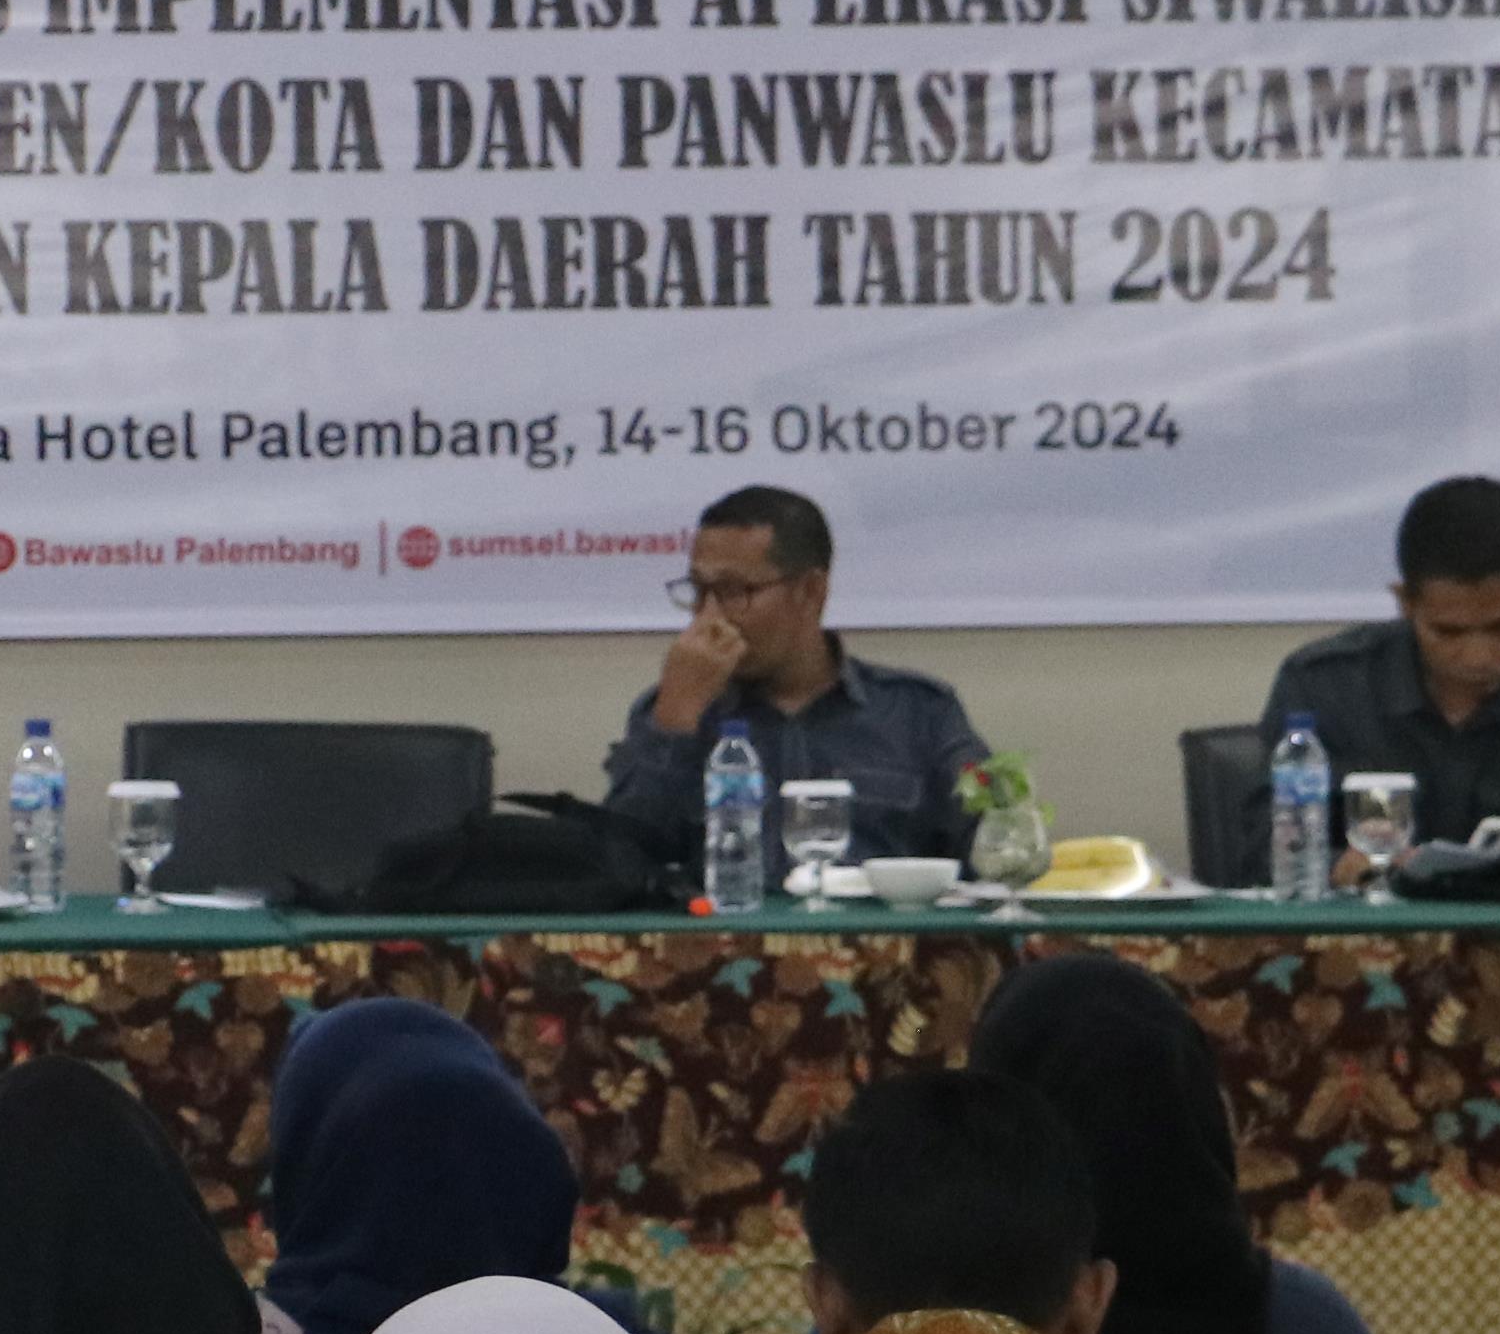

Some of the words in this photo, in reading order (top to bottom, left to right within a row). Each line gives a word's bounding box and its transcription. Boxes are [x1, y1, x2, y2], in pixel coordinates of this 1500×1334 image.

[413, 74, 585, 171] DAN
[617, 69, 1058, 169] PANWASLU
[63, 217, 389, 315] KEPALA
[419, 213, 770, 312] DAERAH
[803, 210, 1077, 307] TAHUN
[1108, 207, 1336, 304] 2024
[35, 410, 200, 462] Hotel
[221, 407, 577, 470] Palembang,
[597, 405, 751, 456] 14-16
[771, 402, 1017, 454] Oktober
[1035, 401, 1182, 451] 2024
[24, 537, 164, 565] Bawaslu
[174, 535, 361, 569] Palembang
